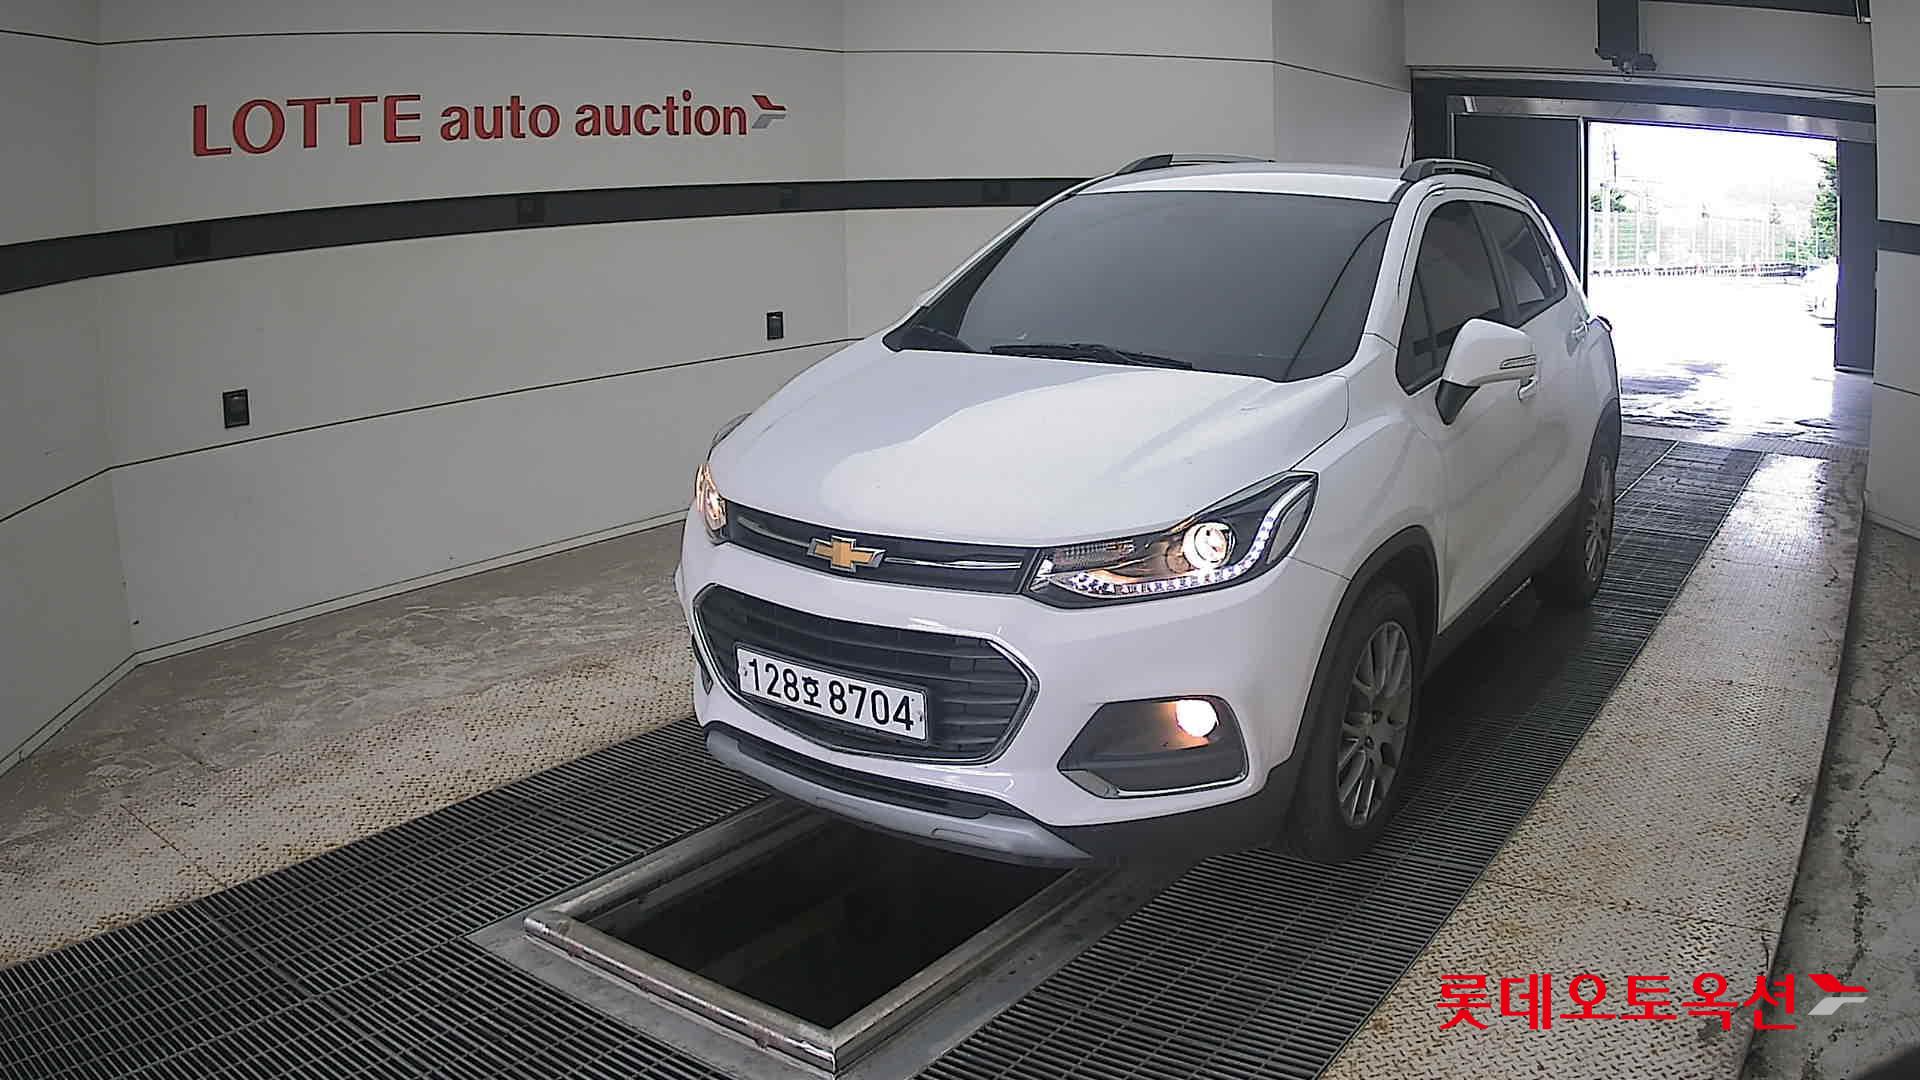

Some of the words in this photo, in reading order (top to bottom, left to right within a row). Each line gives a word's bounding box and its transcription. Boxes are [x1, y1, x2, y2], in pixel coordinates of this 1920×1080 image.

[193, 95, 421, 156] LOTTE
[440, 95, 561, 140] auto
[574, 90, 747, 136] auction
[749, 658, 823, 709] 128호
[828, 680, 915, 731] 8704
